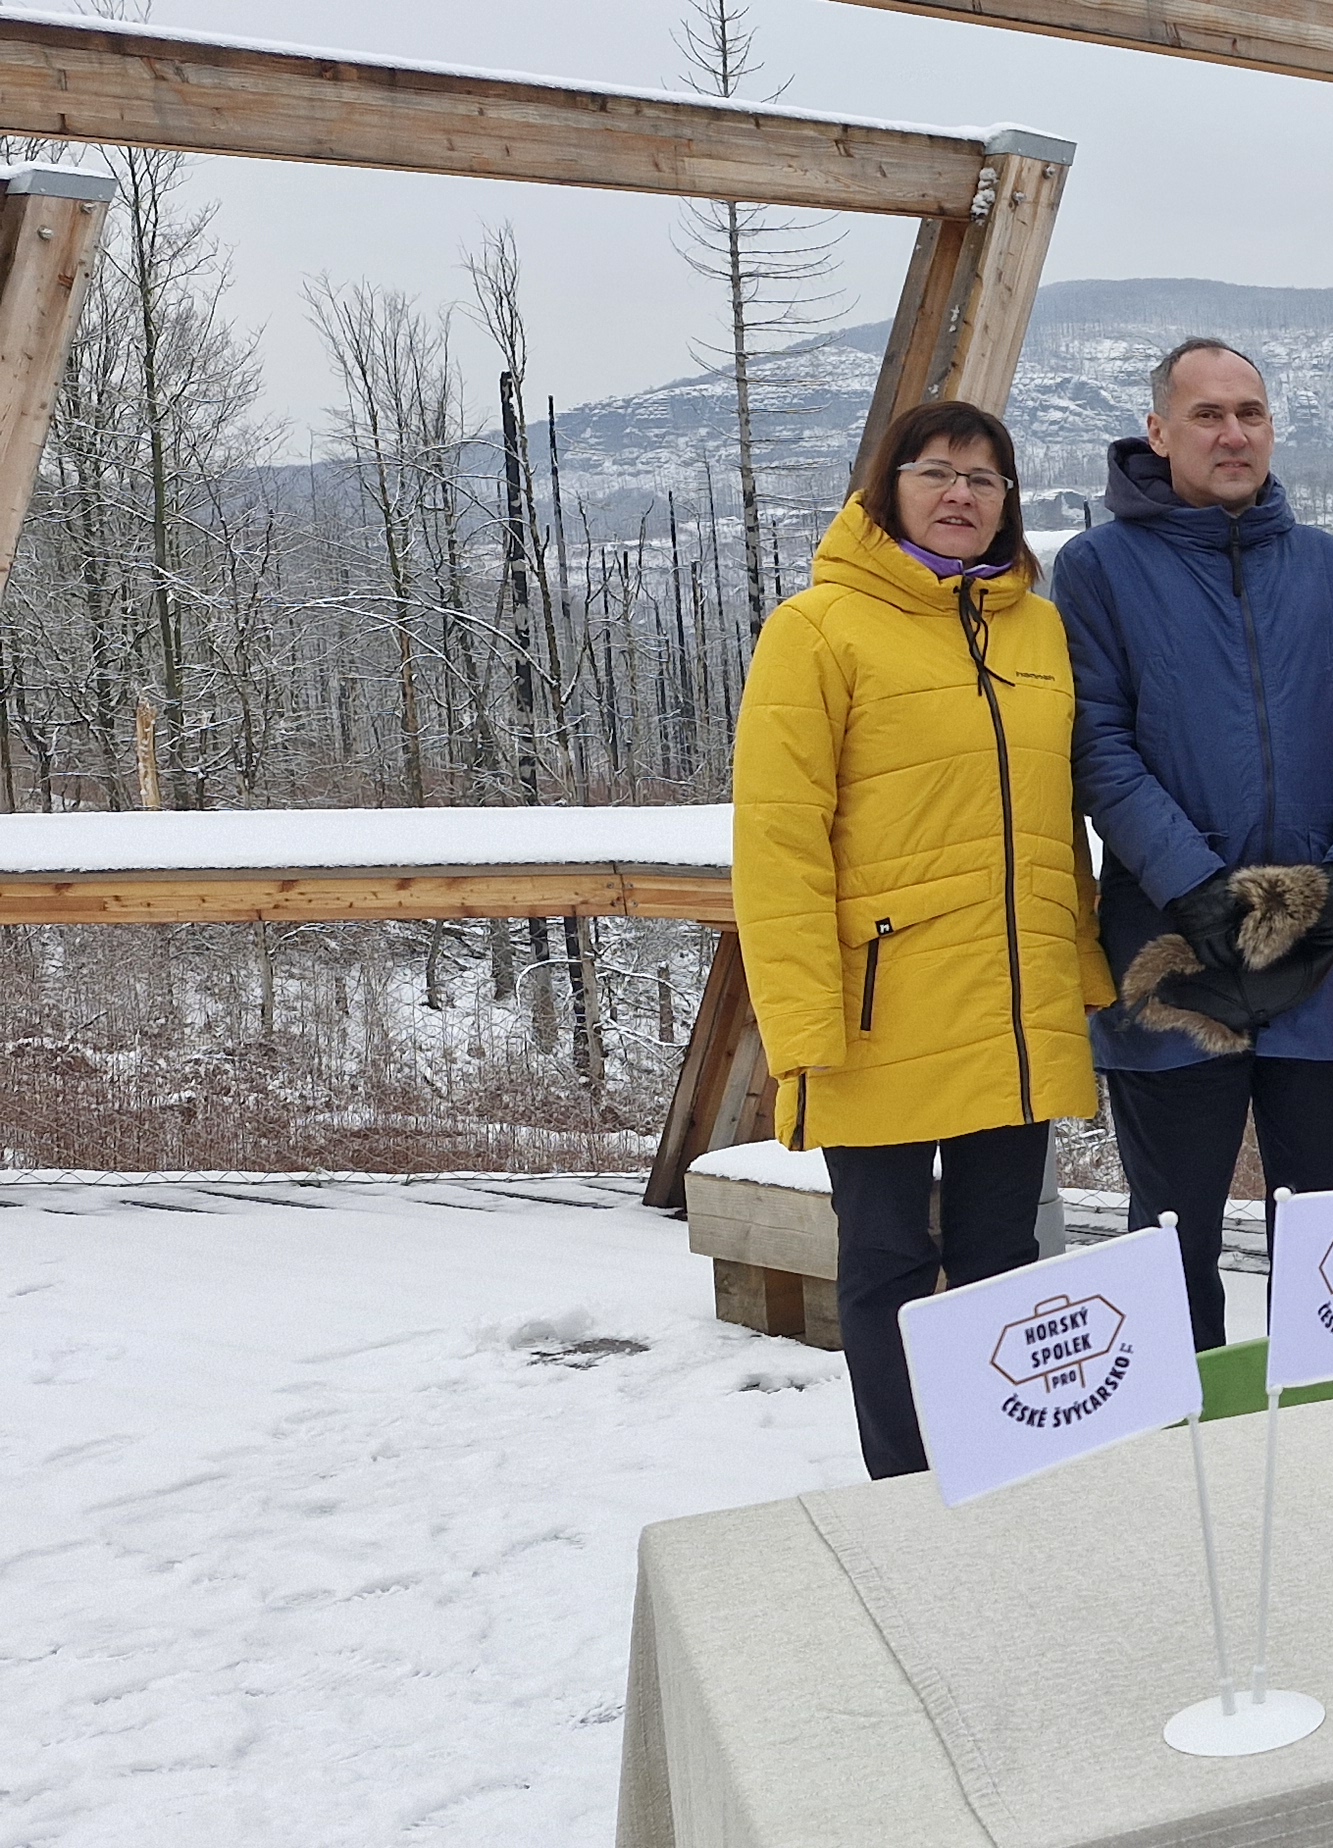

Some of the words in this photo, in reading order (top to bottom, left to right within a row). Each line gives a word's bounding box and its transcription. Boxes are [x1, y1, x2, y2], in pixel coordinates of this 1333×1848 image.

[1024, 1306, 1089, 1345] HORSKÝ
[1031, 1333, 1092, 1368] SPOLEK
[1001, 1393, 1048, 1428] ČESKÉ
[1052, 1356, 1131, 1429] ŠVÝCARSKO
[1051, 1370, 1077, 1389] PRO
